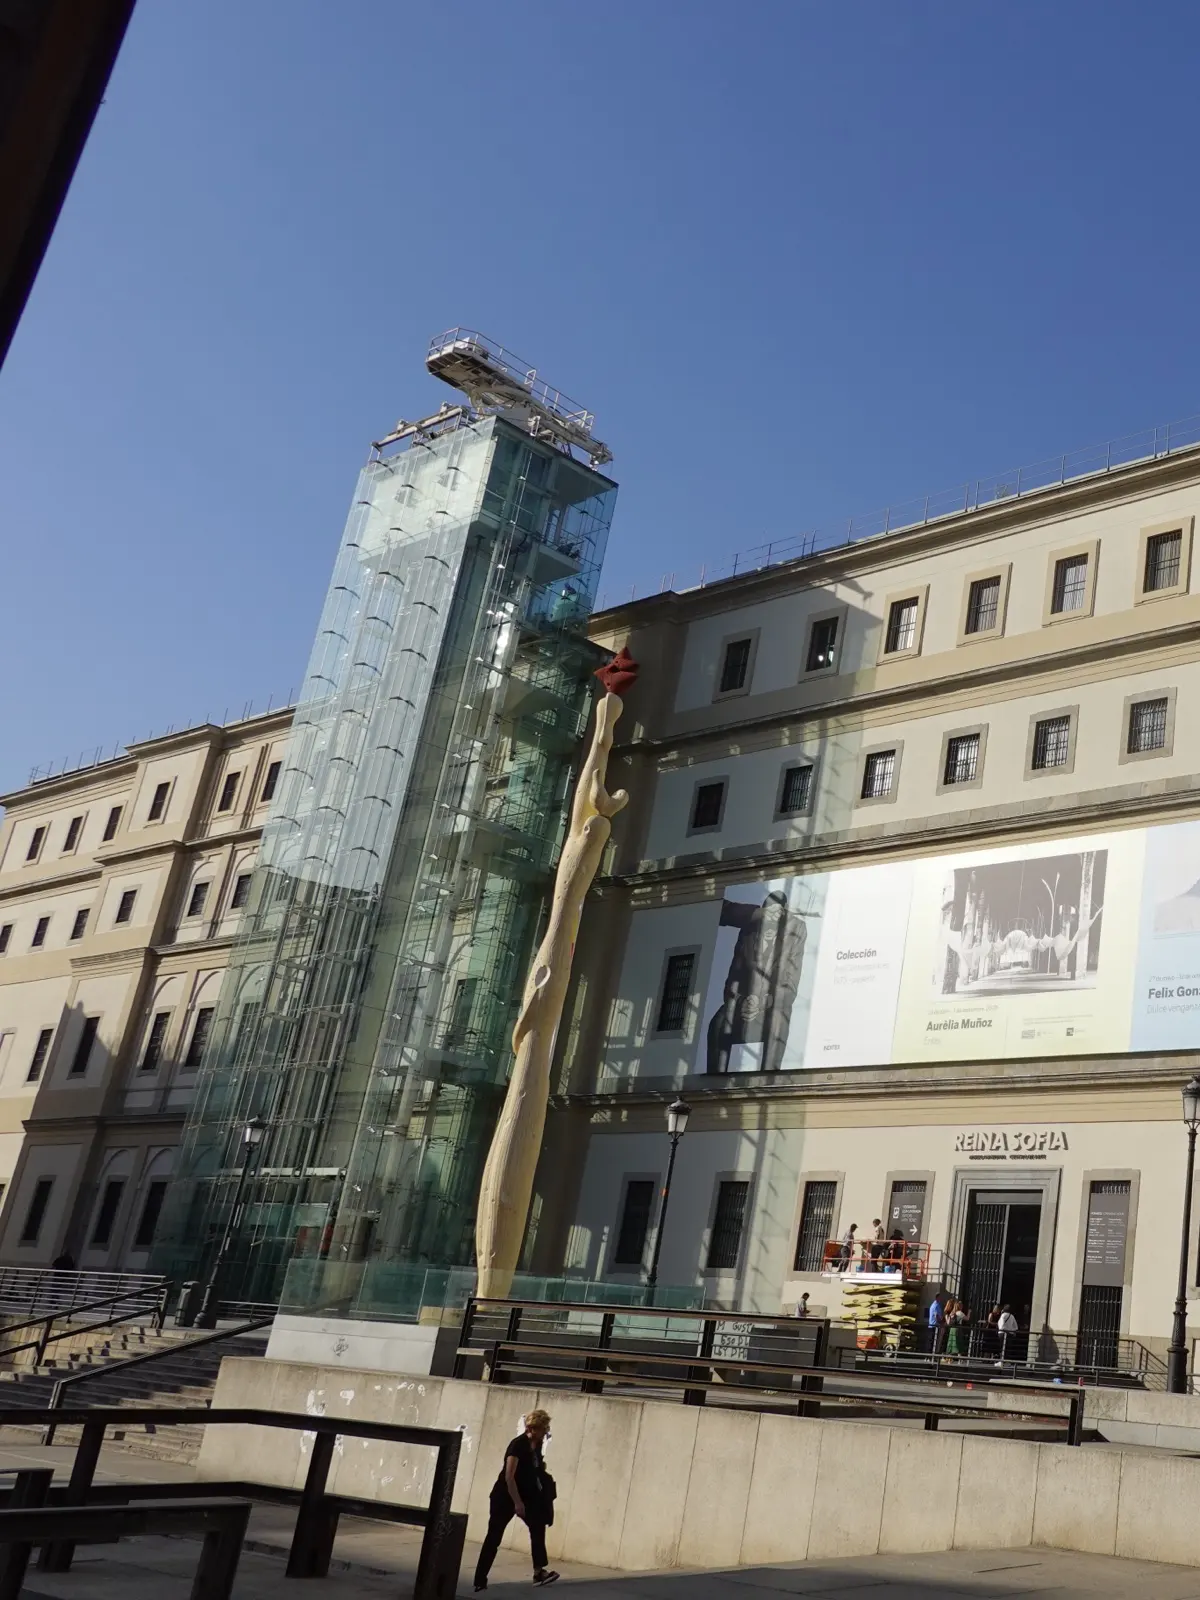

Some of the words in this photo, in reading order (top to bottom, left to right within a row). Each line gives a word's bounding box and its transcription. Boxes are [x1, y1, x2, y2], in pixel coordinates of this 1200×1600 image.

[836, 948, 877, 961] Colección
[1147, 987, 1174, 999] Felix
[925, 1019, 959, 1032] Aurèlia
[960, 1017, 993, 1030] Muñoz
[954, 1131, 1009, 1152] REINA
[1013, 1131, 1070, 1152] SOFIA
